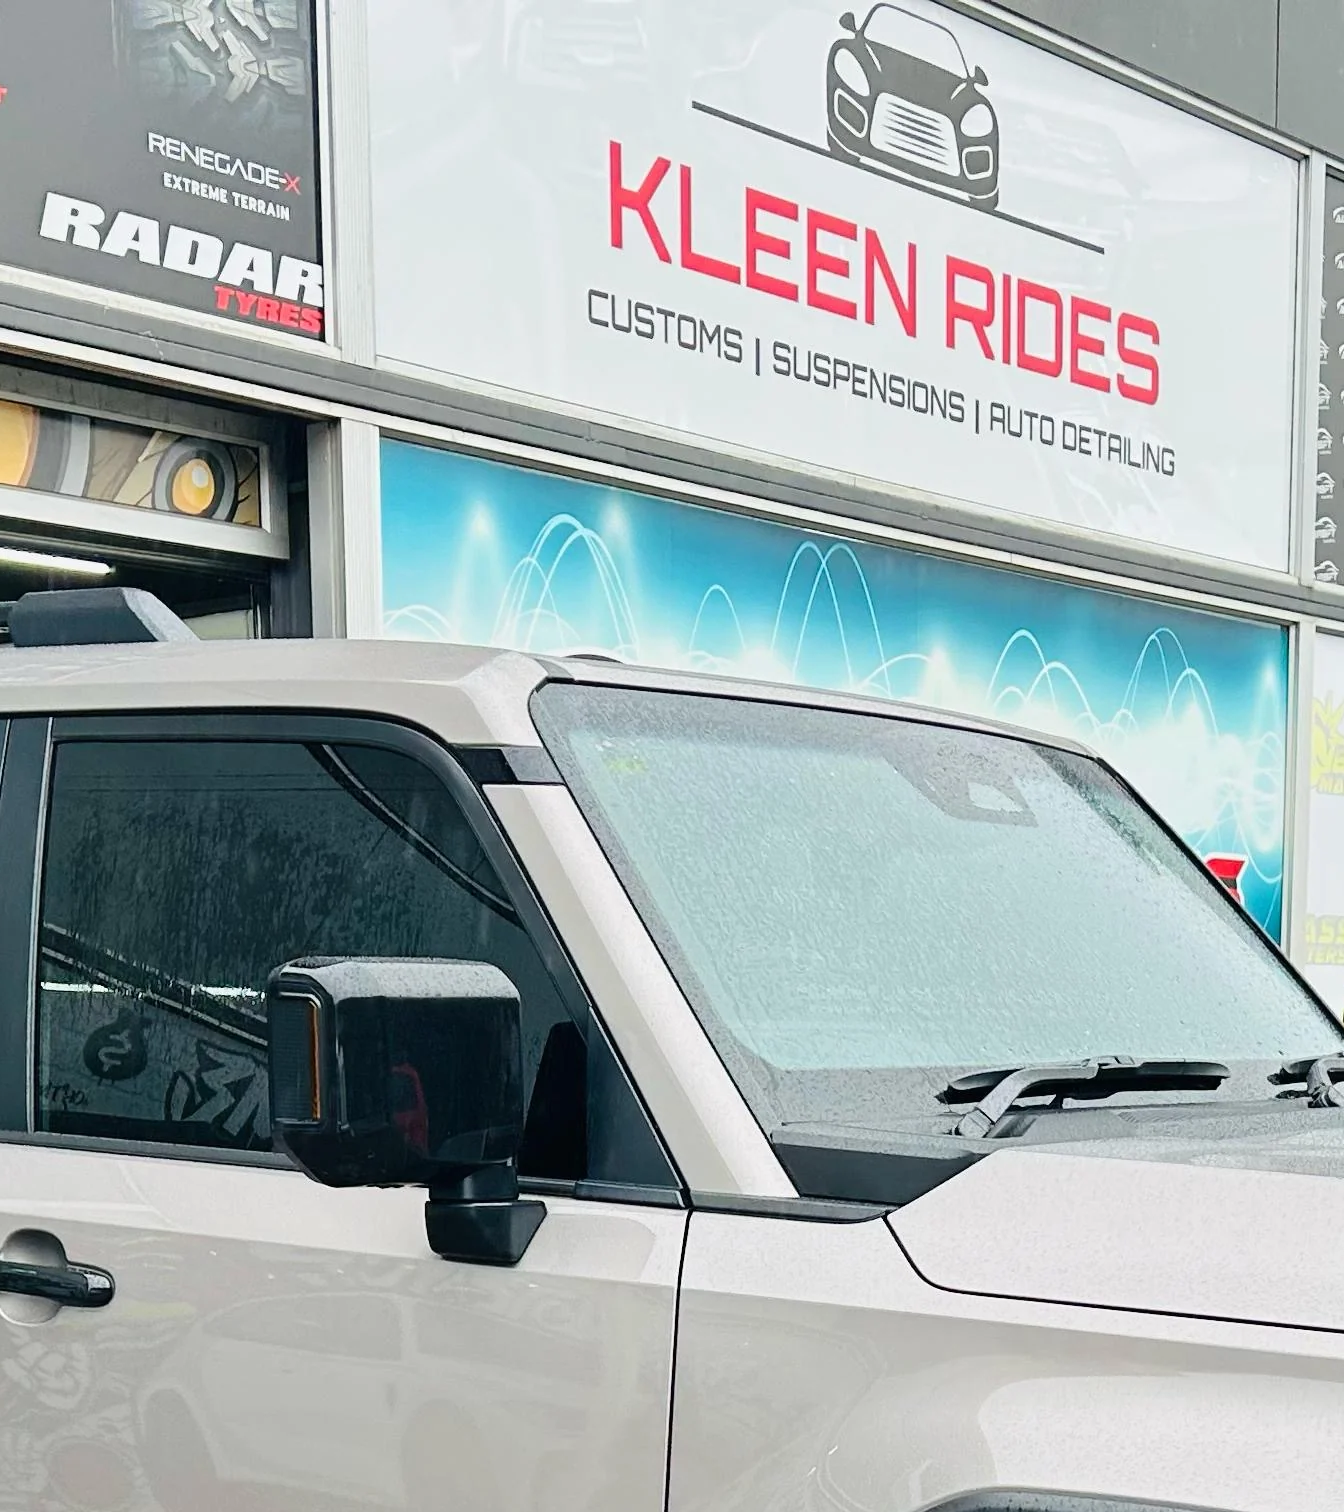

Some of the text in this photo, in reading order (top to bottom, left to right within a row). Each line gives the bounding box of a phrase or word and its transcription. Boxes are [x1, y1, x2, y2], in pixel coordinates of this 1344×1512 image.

[39, 191, 324, 307] RADAR
[163, 172, 290, 221] EXTREME TERRAIN
[214, 285, 322, 333] TYRES
[609, 139, 1160, 406] KLEEN RIDES
[587, 288, 1175, 477] CUSTOMS SUSPENSIONS AUTO DETAILING
